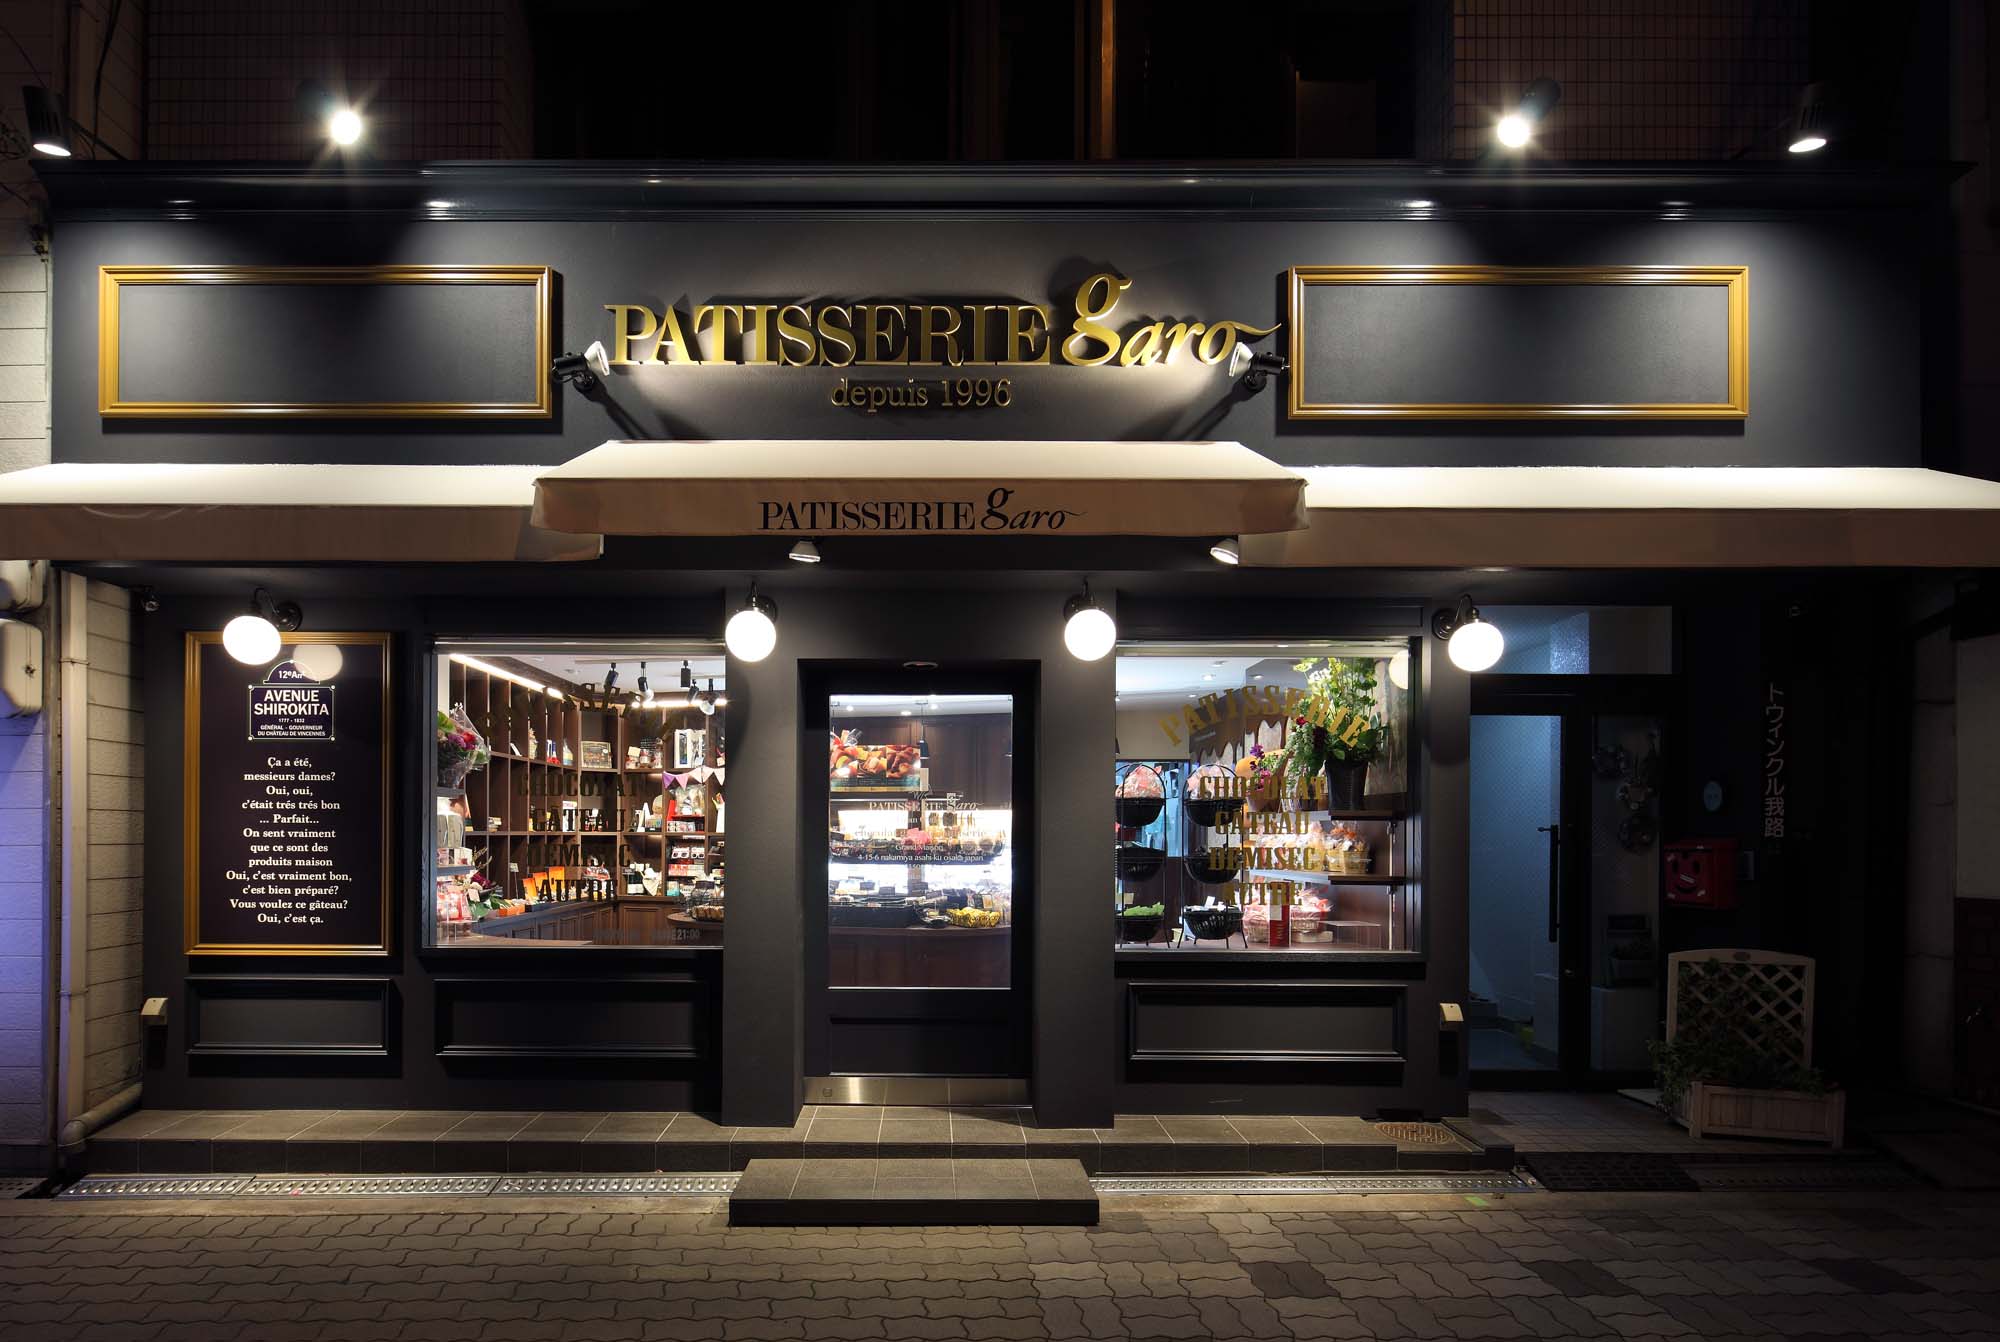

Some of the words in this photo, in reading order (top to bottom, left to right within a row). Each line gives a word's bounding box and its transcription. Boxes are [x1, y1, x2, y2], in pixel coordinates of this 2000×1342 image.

[604, 303, 1050, 367] PATISSERIE
[1061, 272, 1282, 367] garo
[831, 377, 929, 414] depuis
[941, 377, 1012, 409] 1996
[757, 501, 975, 531] PATISSERIE
[980, 487, 1088, 530] garo
[264, 690, 319, 702] AVENUE
[254, 703, 329, 716] SHIROKITA
[268, 757, 281, 769] Ça
[294, 757, 312, 769] été,
[244, 772, 295, 781] messieurs
[298, 772, 336, 781] dames?
[266, 785, 289, 796] Oui,
[293, 786, 313, 796] oui,
[321, 800, 340, 809] bon
[243, 828, 260, 837] On
[288, 828, 336, 837] vraiment
[250, 845, 270, 855] que
[286, 843, 309, 852] sont
[312, 843, 328, 852] des
[248, 856, 292, 868] produits
[295, 857, 333, 866] maison
[226, 870, 250, 882] Oui,
[278, 871, 326, 880] vraiment
[330, 871, 352, 882] bon,
[268, 885, 291, 894] bien
[294, 885, 339, 897] préparé?
[230, 899, 256, 909] Vous
[259, 899, 292, 909] voulez
[309, 899, 348, 911] gâteau?
[257, 913, 281, 924] Oui,
[310, 916, 324, 925] ça.
